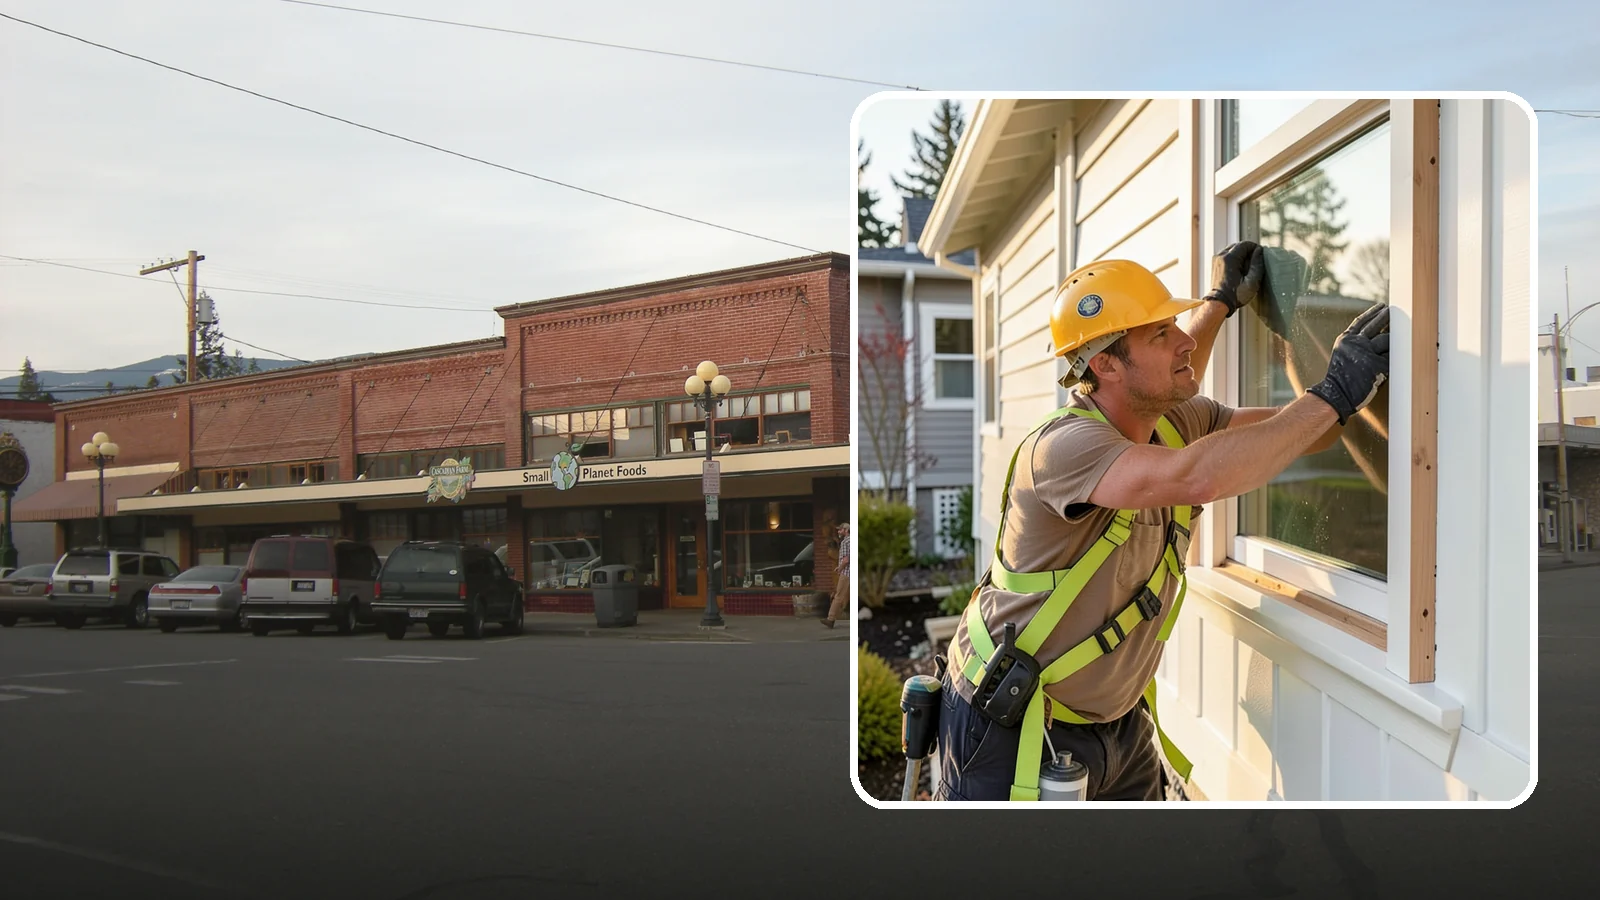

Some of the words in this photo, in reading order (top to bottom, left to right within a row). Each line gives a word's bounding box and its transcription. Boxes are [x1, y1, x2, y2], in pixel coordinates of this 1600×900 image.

[522, 470, 549, 483] Small
[582, 466, 614, 479] Planet
[616, 464, 647, 477] Foods
